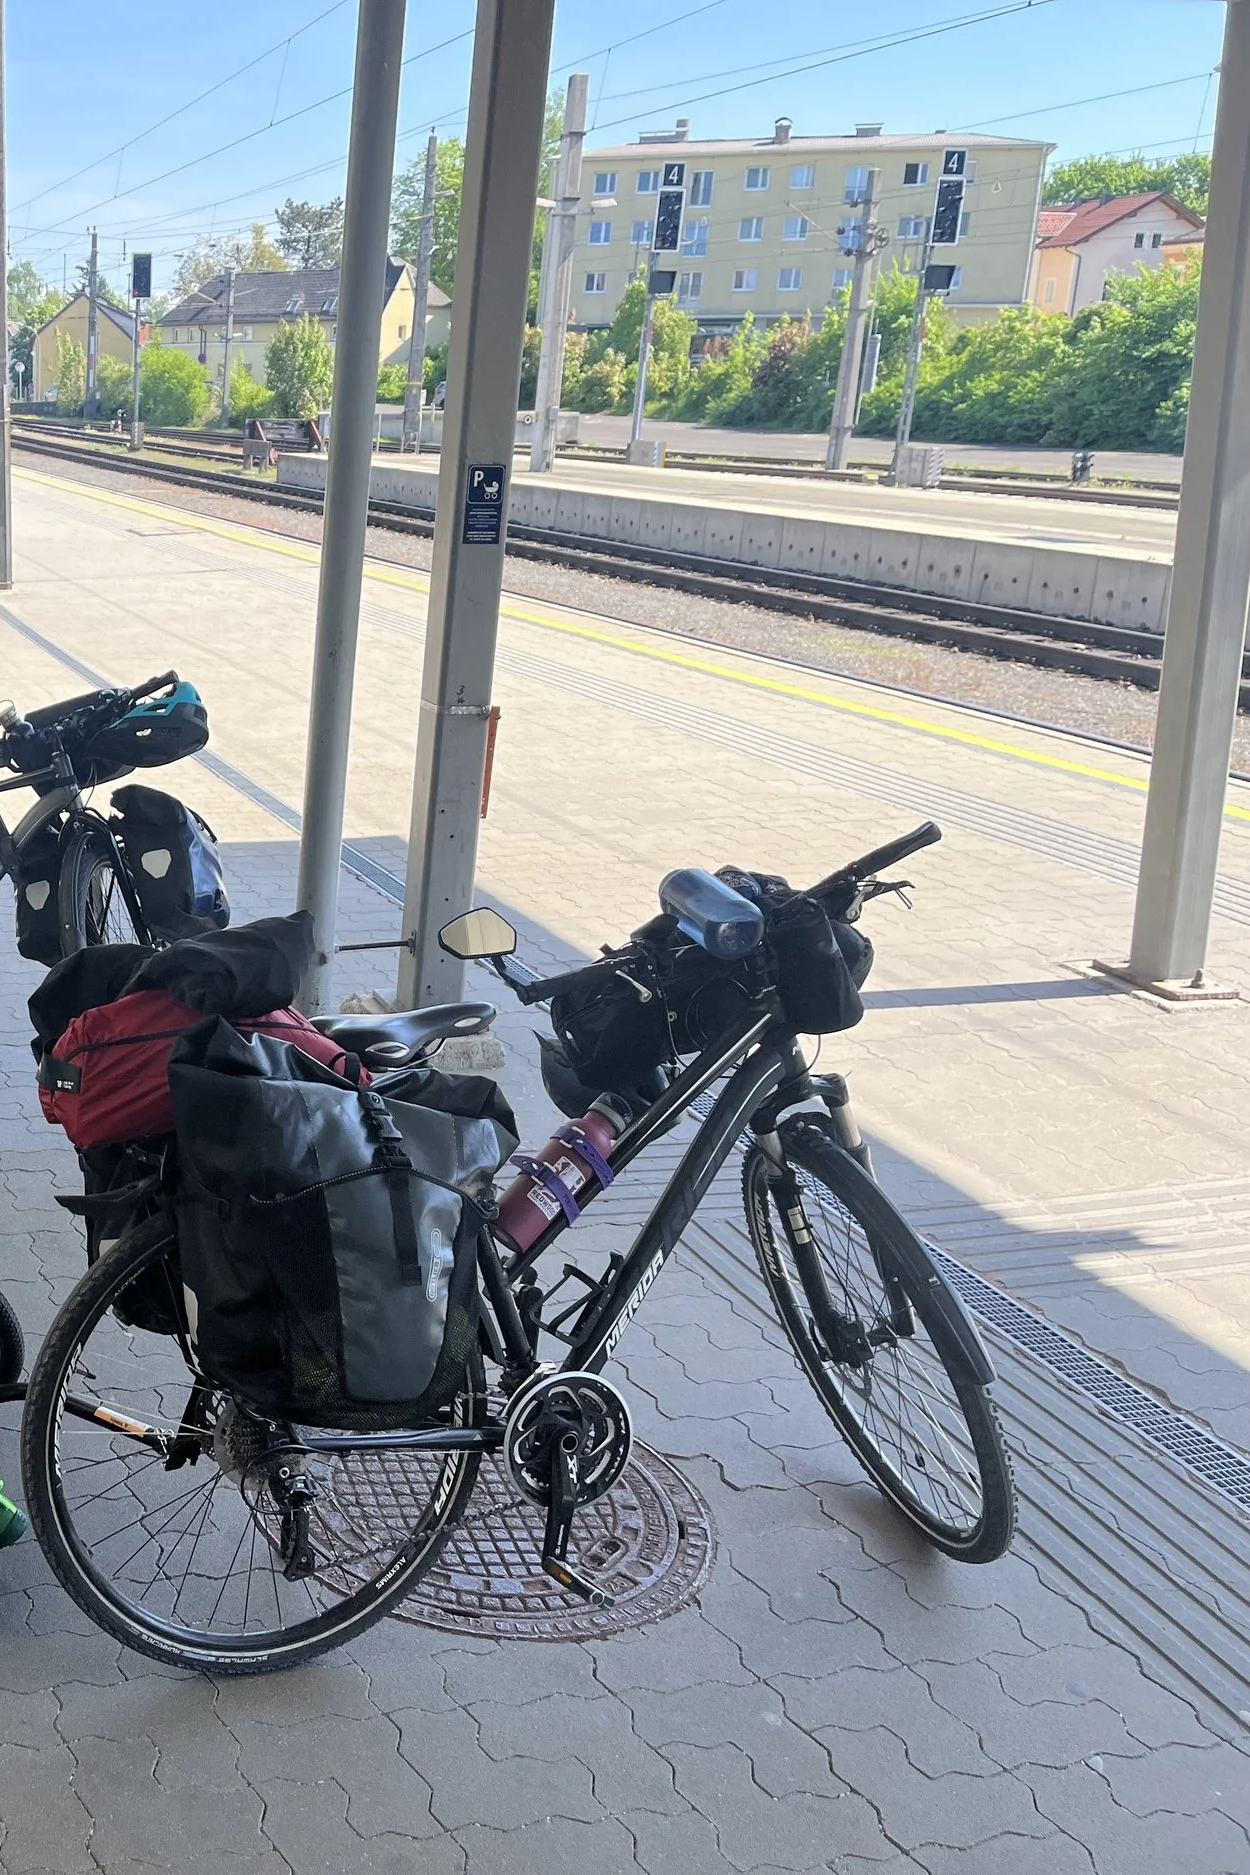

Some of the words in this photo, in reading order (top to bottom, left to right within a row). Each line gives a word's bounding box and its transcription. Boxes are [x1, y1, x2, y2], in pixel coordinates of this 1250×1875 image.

[948, 152, 959, 173] 4
[668, 165, 679, 185] 4
[473, 470, 484, 488] P
[605, 1248, 665, 1358] MERIDA
[566, 1455, 579, 1485] XT
[375, 1556, 407, 1589] ALEXRIMS
[218, 1654, 269, 1664] SCHWALBE
